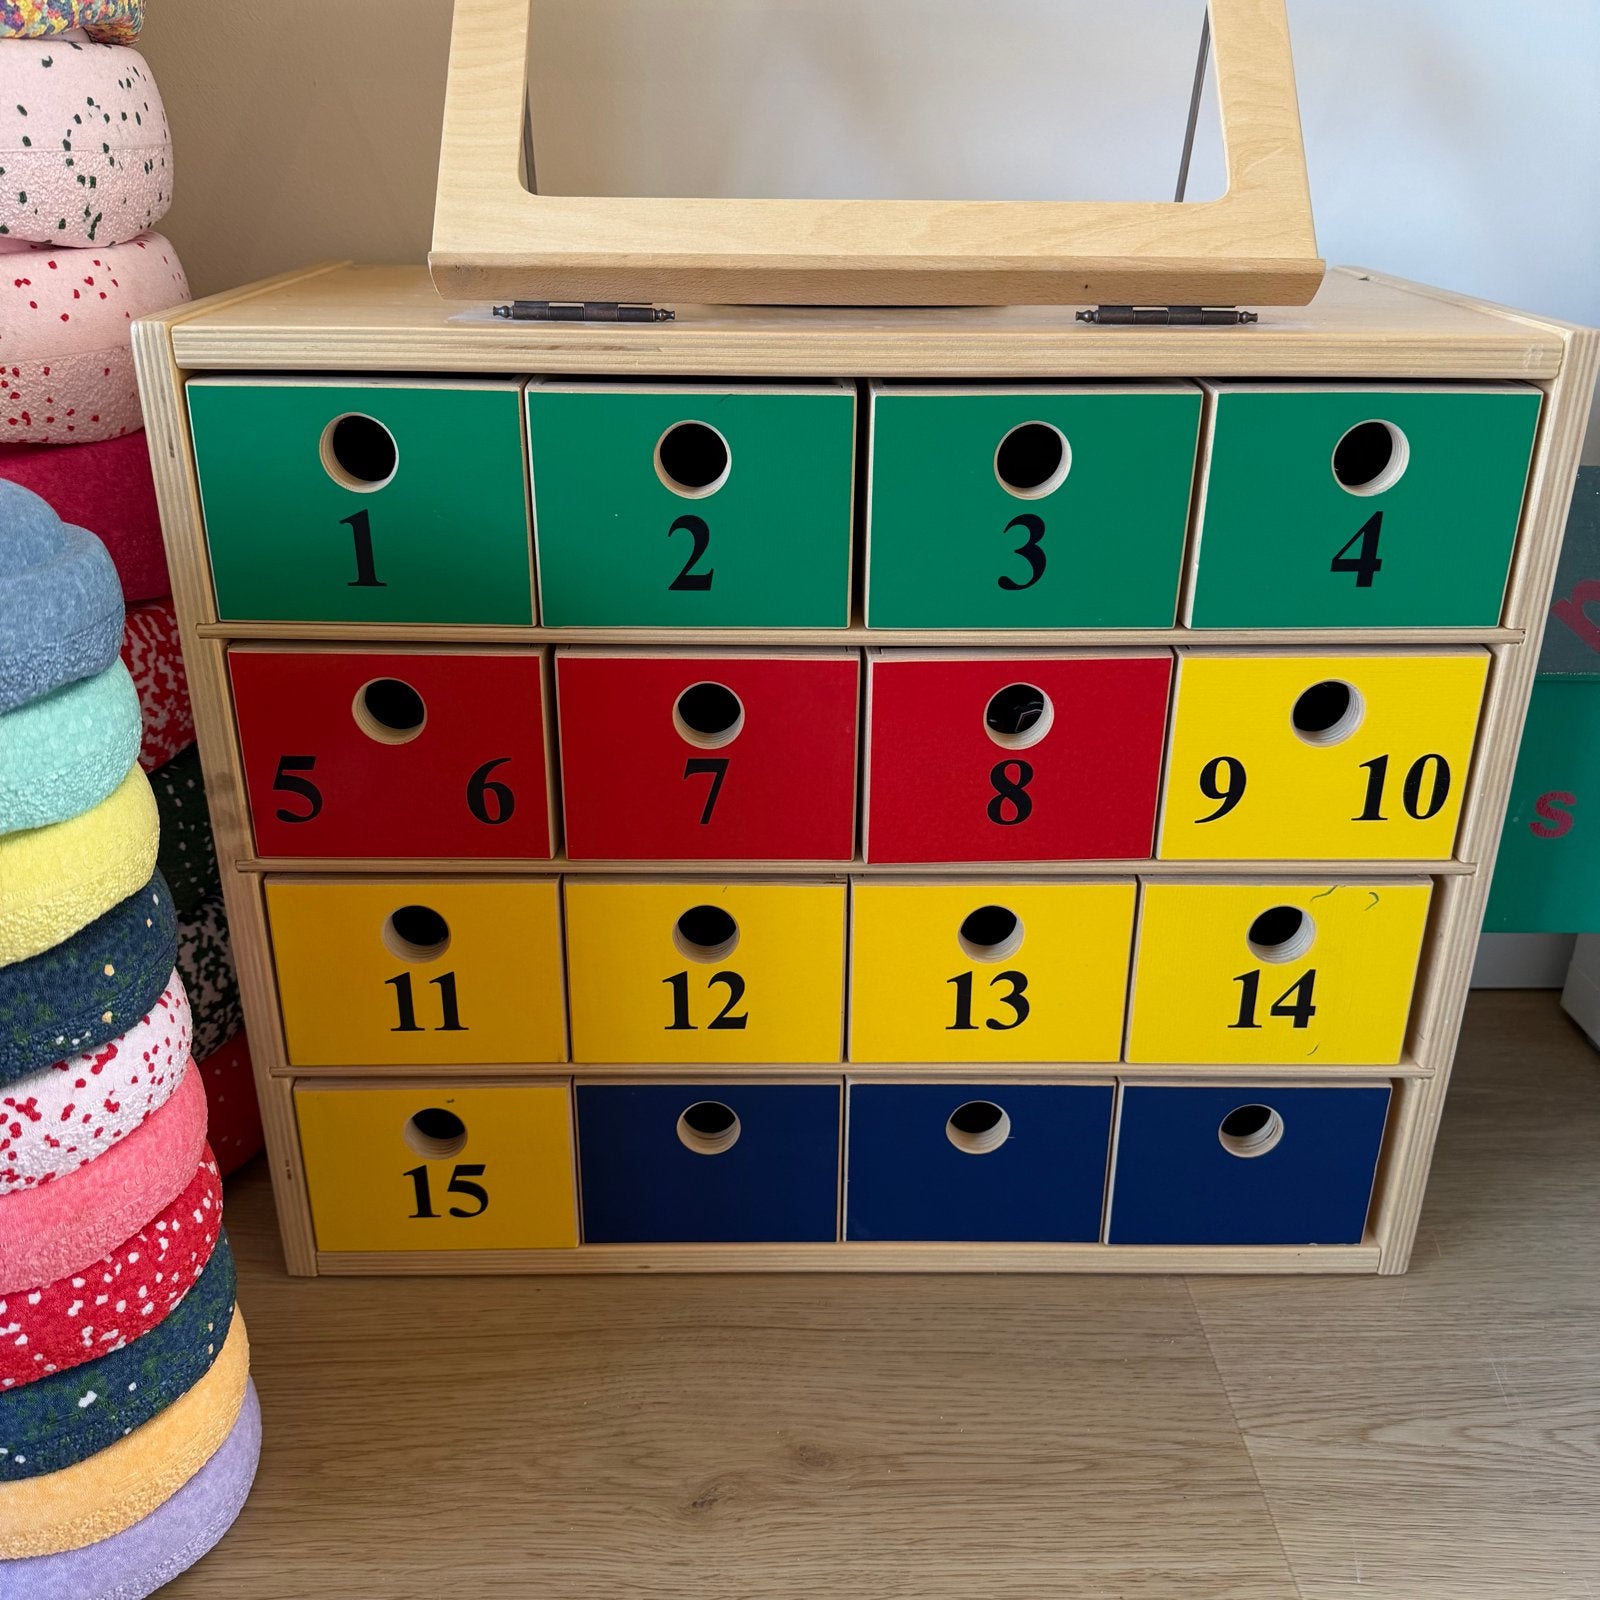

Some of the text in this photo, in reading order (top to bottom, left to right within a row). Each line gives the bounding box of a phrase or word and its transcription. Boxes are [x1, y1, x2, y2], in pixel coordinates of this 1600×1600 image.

[340, 508, 388, 586] 1
[668, 515, 713, 591] 2
[998, 514, 1046, 590] 3
[1331, 511, 1383, 587] 4
[273, 756, 514, 824] 5 6
[684, 759, 729, 824] 7
[988, 760, 1033, 825] 8
[1195, 754, 1450, 824] 9 10
[385, 972, 468, 1031] 11
[663, 971, 748, 1029] 12
[946, 971, 1029, 1030] 13
[1228, 969, 1316, 1028] 14
[403, 1164, 488, 1218] 15
